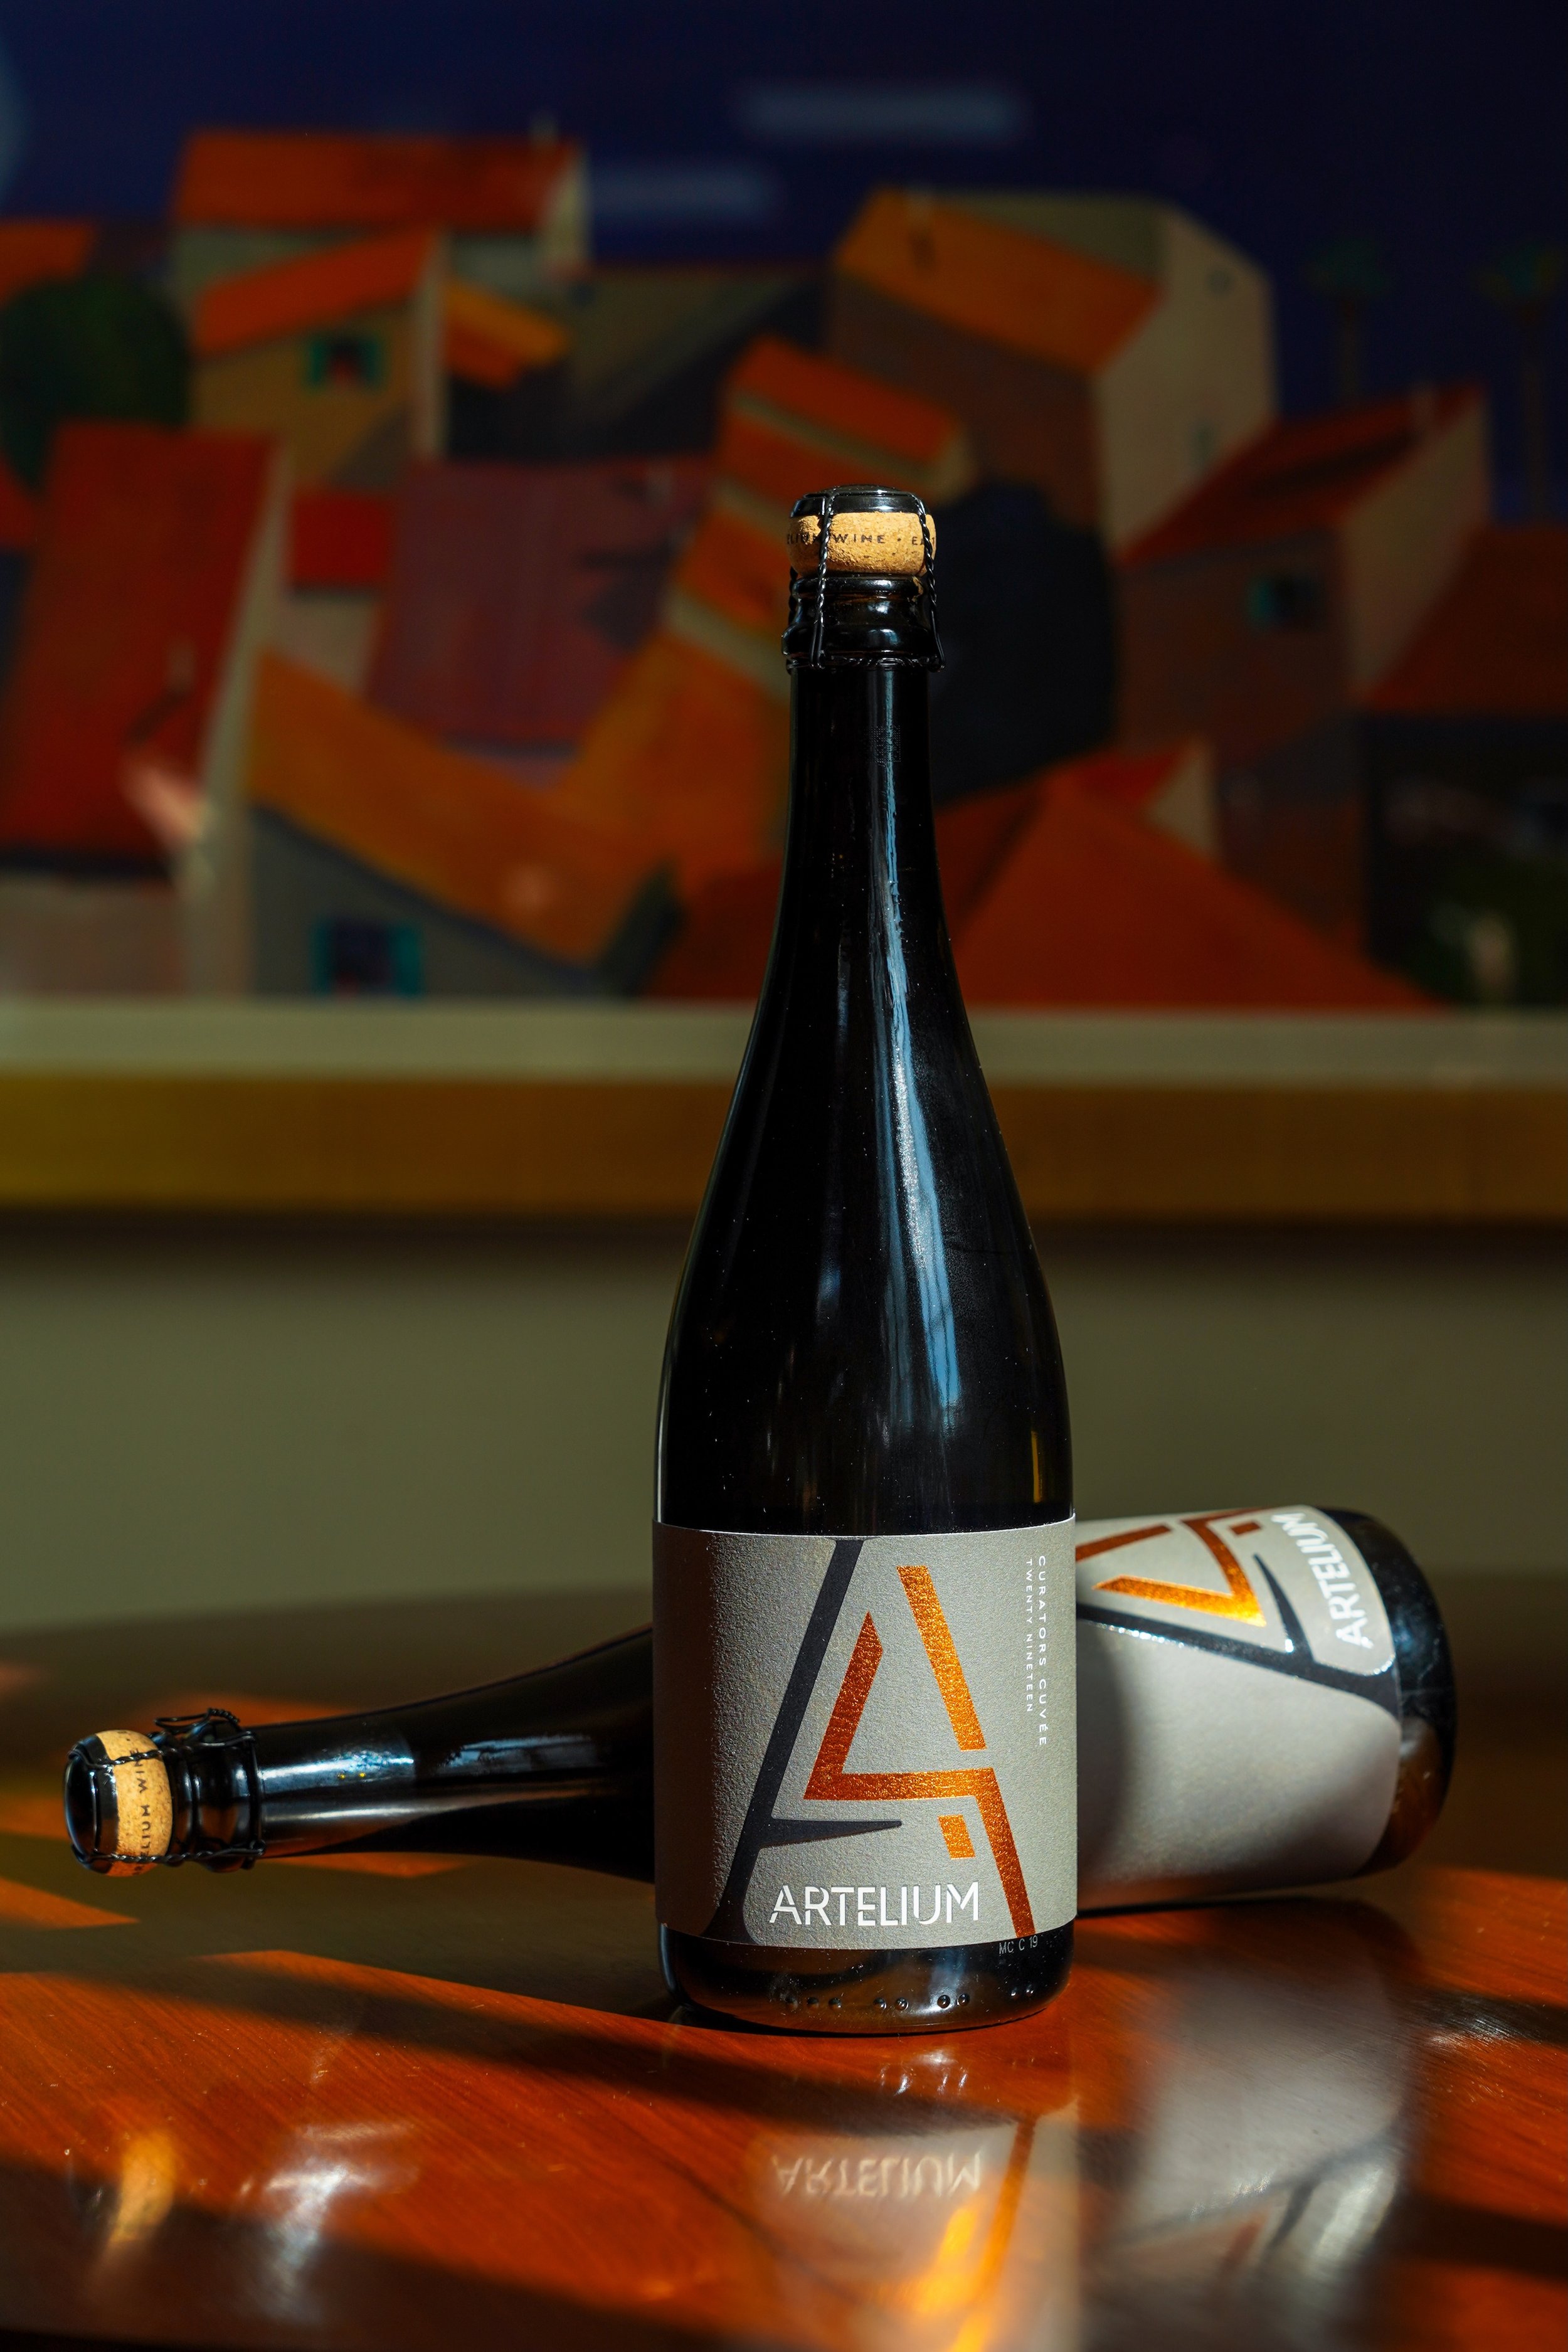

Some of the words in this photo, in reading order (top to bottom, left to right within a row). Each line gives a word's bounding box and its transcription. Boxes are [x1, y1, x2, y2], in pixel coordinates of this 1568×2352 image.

[831, 533, 886, 544] WINE
[1038, 1555, 1047, 1666] CURATORS
[1271, 1512, 1374, 1650] ARTELIUM
[1025, 1633, 1034, 1712] NINETEEN
[1039, 1678, 1049, 1745] CUVÉE
[769, 1881, 980, 1927] ARTELIUM
[999, 1941, 1014, 1954] MC
[1019, 1938, 1025, 1951] C
[1029, 1935, 1038, 1949] 19
